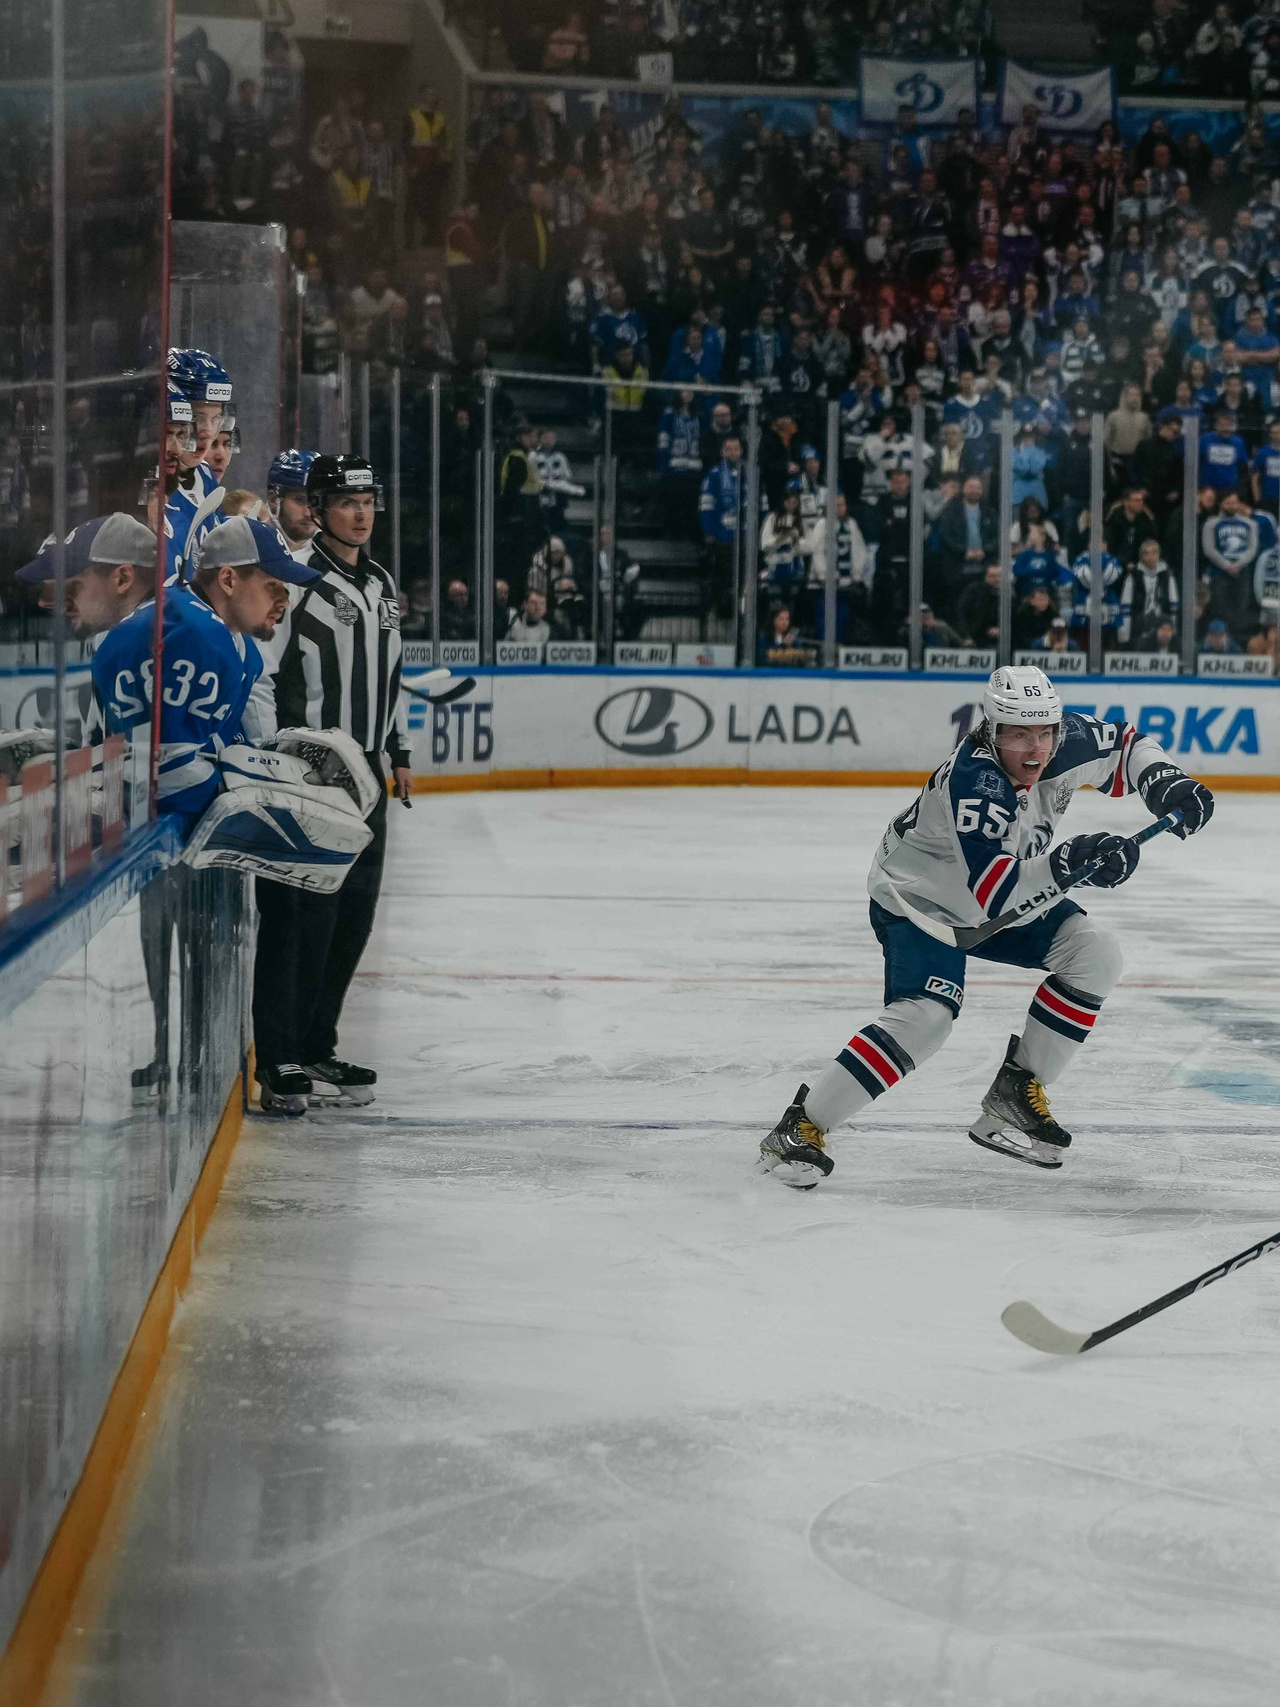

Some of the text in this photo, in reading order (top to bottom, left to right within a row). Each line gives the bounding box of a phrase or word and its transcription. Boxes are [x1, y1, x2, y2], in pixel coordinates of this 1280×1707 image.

[843, 652, 903, 667] KHL.RU
[929, 654, 991, 669] KHL.RU
[1020, 656, 1082, 671] KHL.RU
[1108, 657, 1173, 672] KHL.RU
[1202, 659, 1268, 674] KHL.RU
[163, 659, 219, 720] 32
[1023, 685, 1042, 697] 65
[1020, 709, 1050, 718] согаз
[431, 702, 495, 763] ВТБ
[727, 703, 862, 747] LADA
[956, 798, 1011, 840] 65
[1014, 882, 1062, 916] CCM
